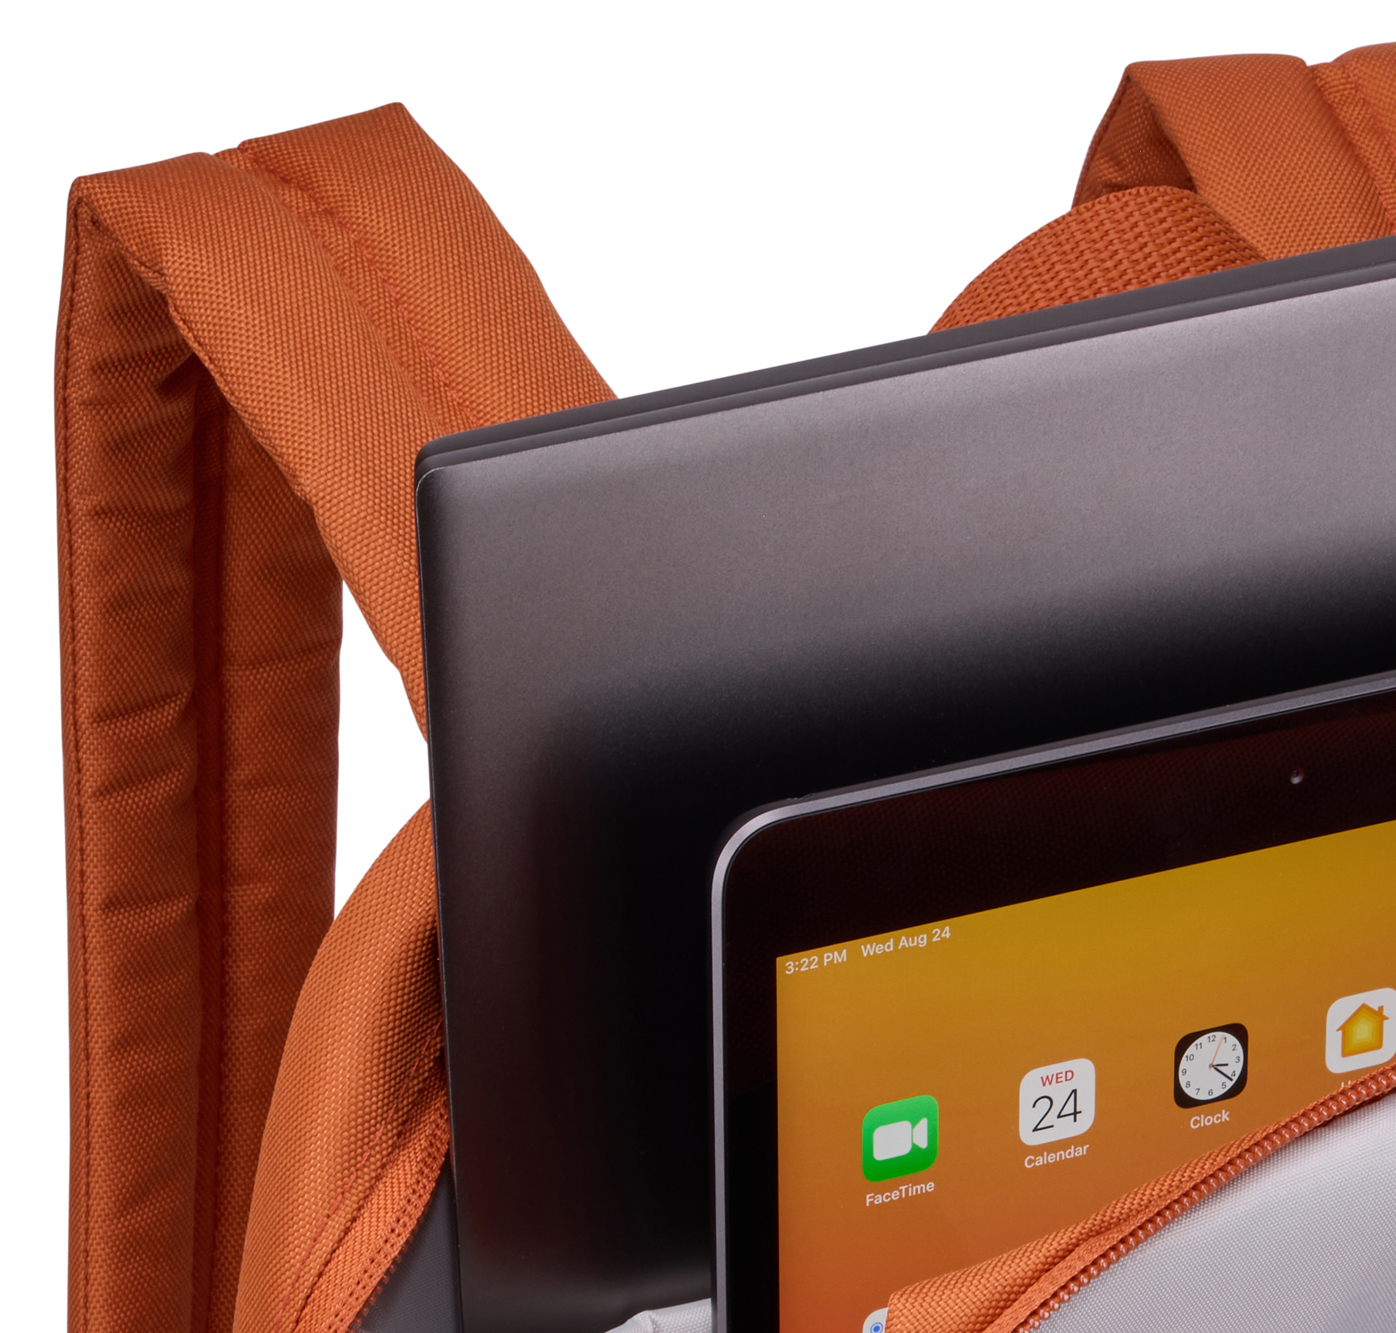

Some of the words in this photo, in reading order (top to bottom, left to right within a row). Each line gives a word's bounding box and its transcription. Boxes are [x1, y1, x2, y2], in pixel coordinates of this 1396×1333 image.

[785, 956, 819, 975] 3:22
[823, 949, 847, 966] PM
[861, 938, 894, 957] Wed
[898, 933, 927, 949] Aug
[931, 926, 951, 942] 24
[1207, 1034, 1217, 1043] 12
[1194, 1042, 1203, 1051] 11
[1232, 1043, 1237, 1051] 2
[1185, 1053, 1195, 1062] 10
[1235, 1056, 1241, 1064] 3
[1181, 1068, 1187, 1076] 9
[1041, 1070, 1075, 1087] WED
[1185, 1080, 1191, 1088] 8
[1031, 1088, 1082, 1133] 24
[1190, 1109, 1230, 1129] Clock
[1024, 1144, 1089, 1169] Calendar
[865, 1181, 935, 1207] FaceTime
